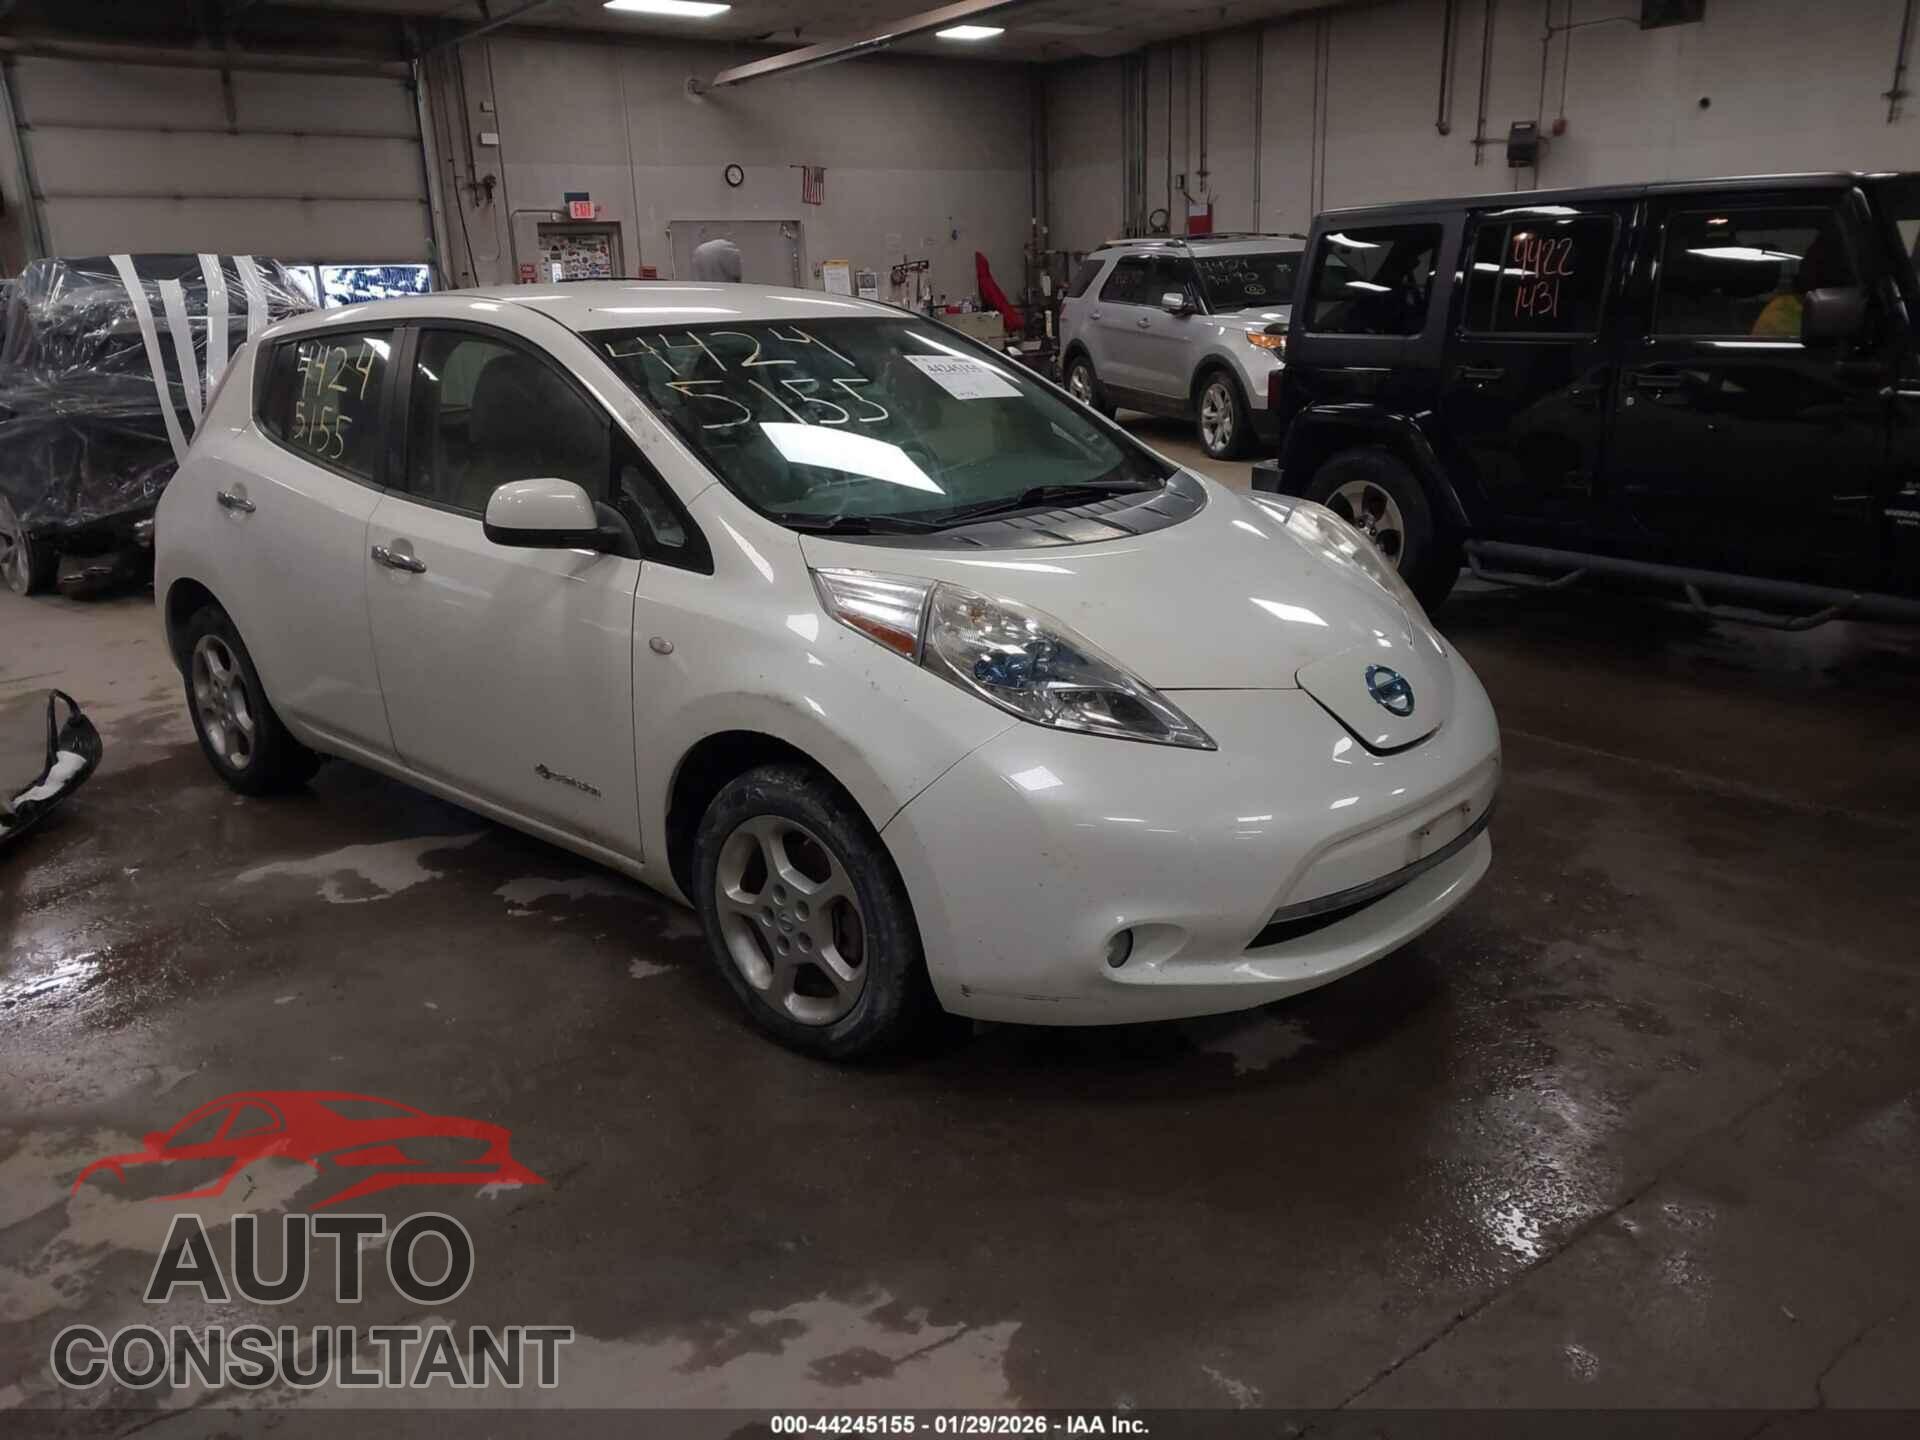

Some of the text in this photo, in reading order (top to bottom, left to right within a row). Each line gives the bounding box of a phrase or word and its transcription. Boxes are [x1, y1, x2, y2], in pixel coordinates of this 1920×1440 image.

[573, 201, 592, 218] EXIT
[1514, 280, 1560, 318] 1431
[297, 340, 378, 401] 4424
[604, 326, 856, 376] 4424
[666, 378, 890, 428] 5155
[293, 400, 353, 459] 5155
